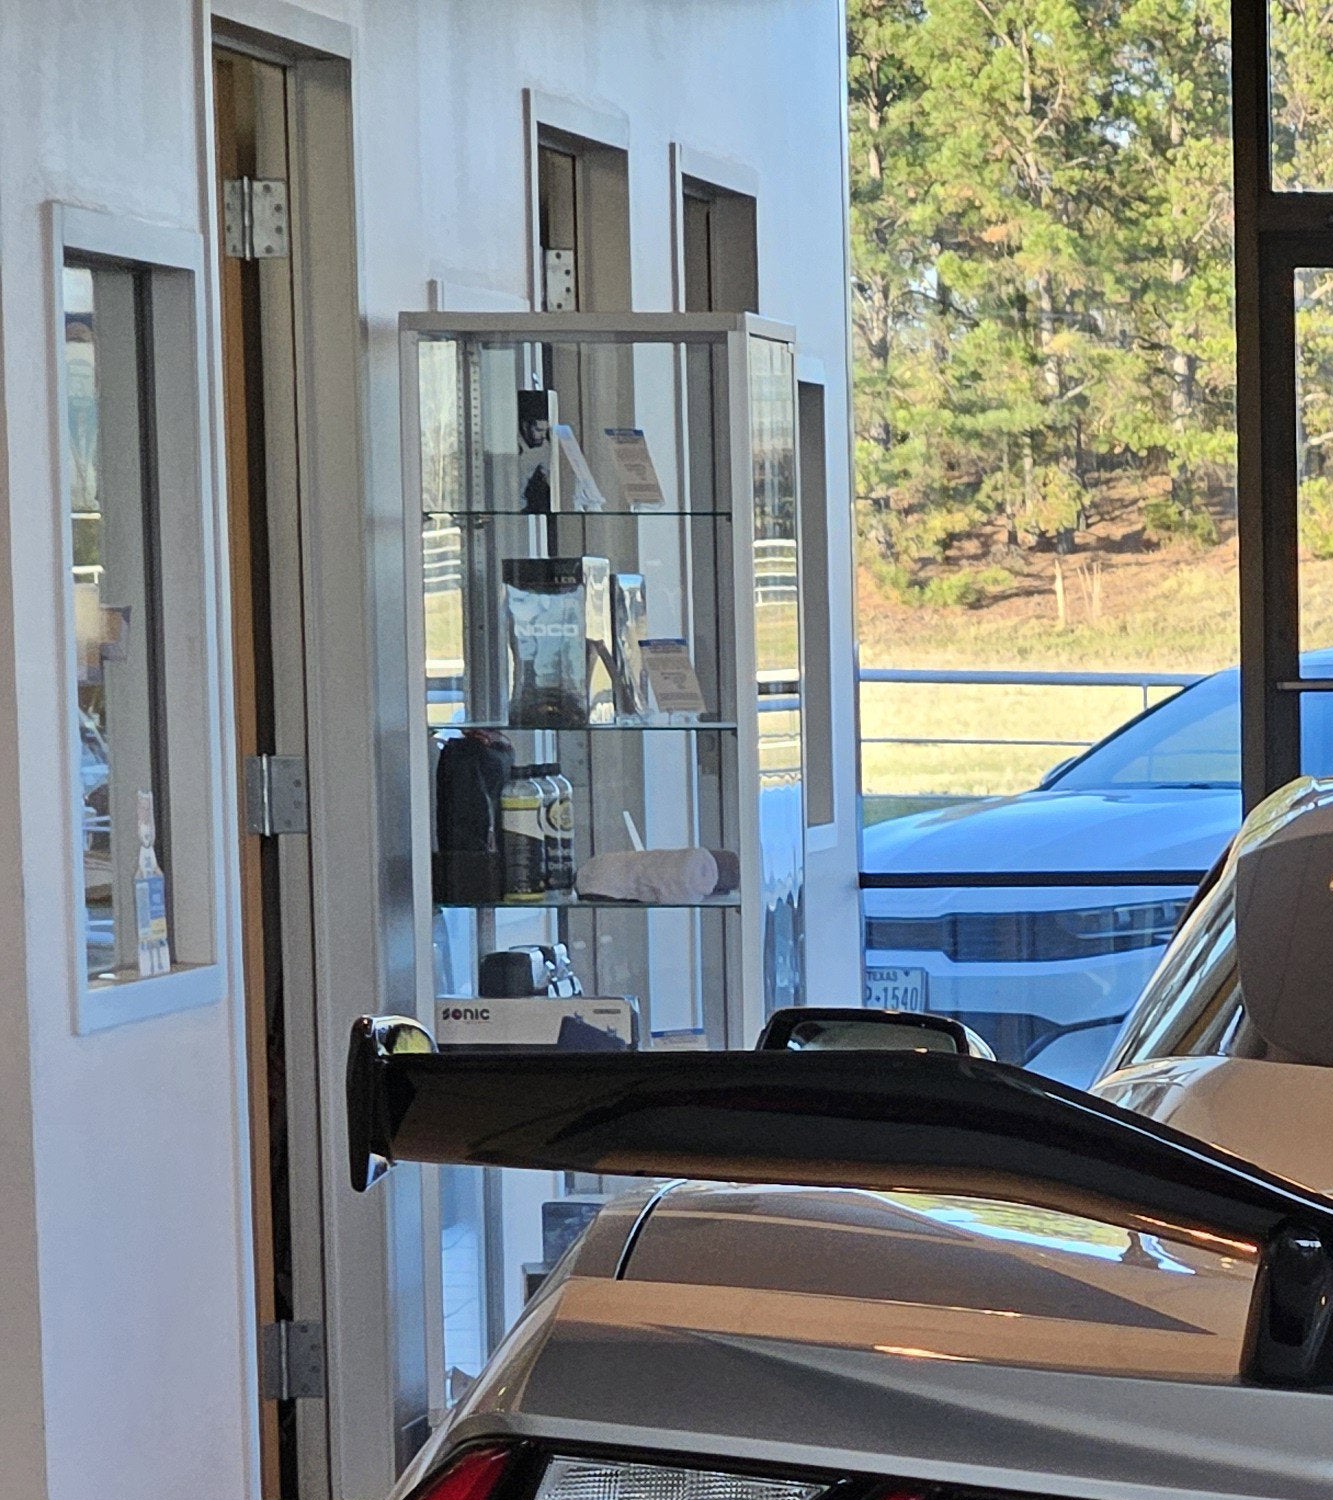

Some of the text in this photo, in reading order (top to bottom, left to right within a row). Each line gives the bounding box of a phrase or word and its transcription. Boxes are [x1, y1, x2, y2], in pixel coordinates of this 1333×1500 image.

[514, 623, 578, 637] NOCO
[866, 970, 898, 982] TEXAS
[882, 986, 919, 1011] 1540
